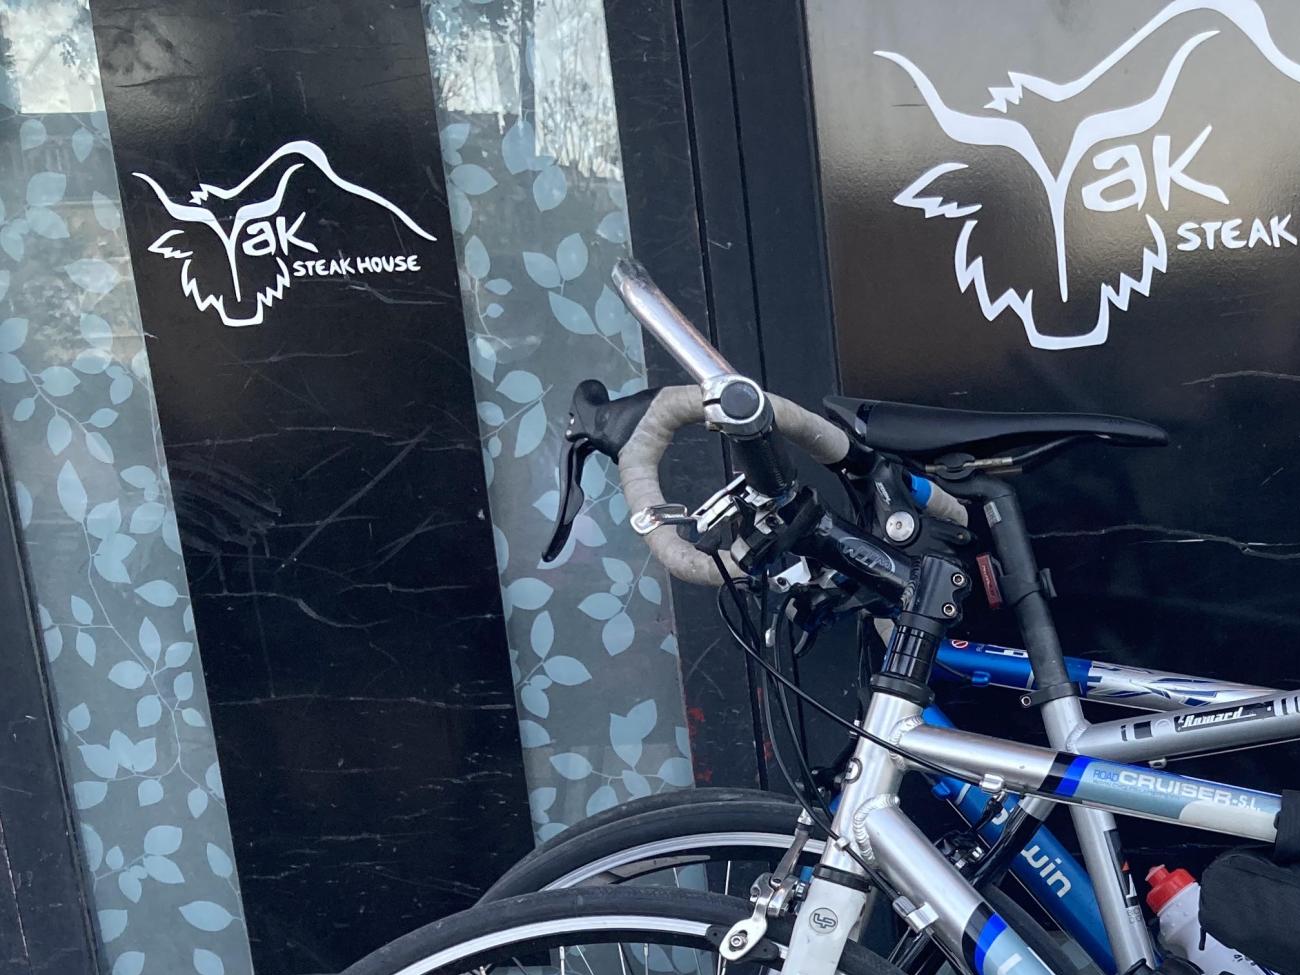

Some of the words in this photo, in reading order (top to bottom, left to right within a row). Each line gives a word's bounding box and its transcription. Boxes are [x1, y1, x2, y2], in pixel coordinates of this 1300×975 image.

[1176, 214, 1298, 252] STEAK
[293, 257, 355, 277] STEAK
[356, 255, 421, 273] HOUSE
[1093, 769, 1119, 783] ROAD
